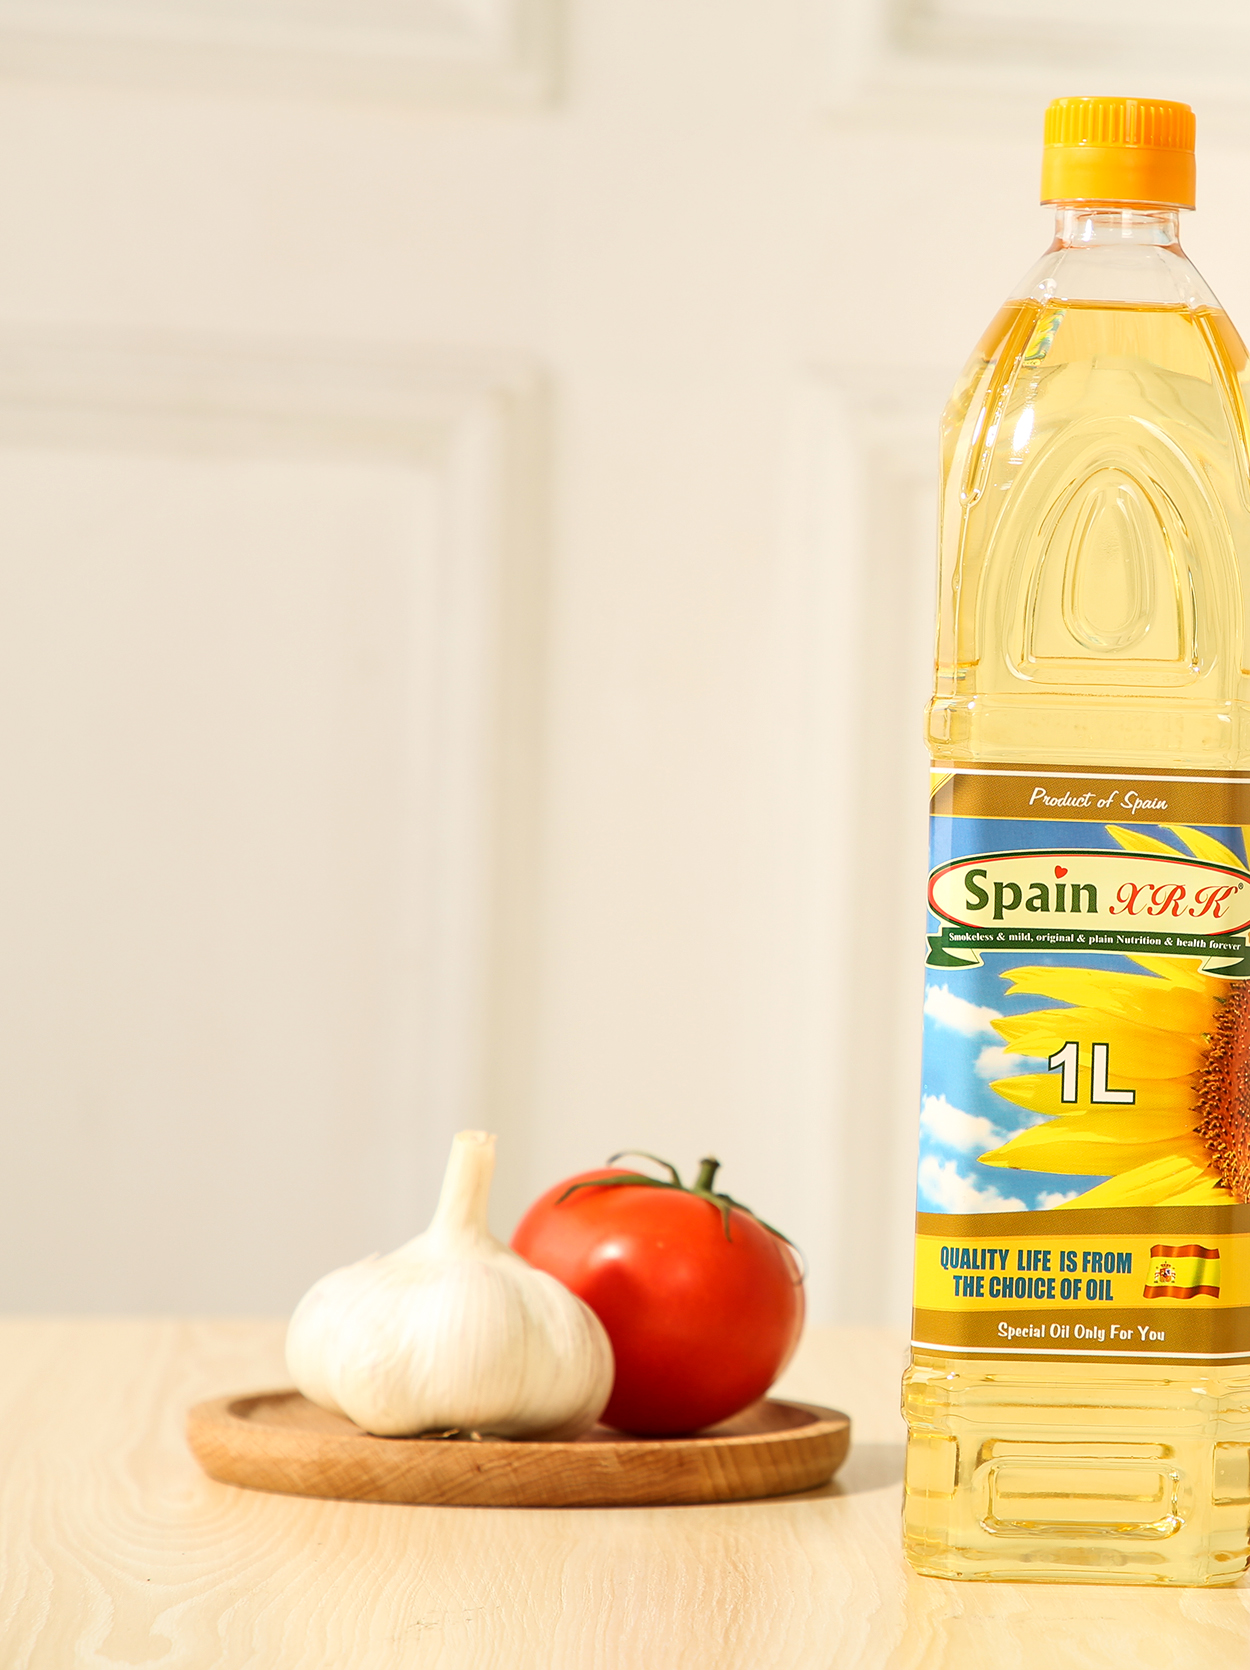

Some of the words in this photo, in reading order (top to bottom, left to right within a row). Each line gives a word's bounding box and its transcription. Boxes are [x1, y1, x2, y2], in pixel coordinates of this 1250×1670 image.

[1029, 787, 1096, 808] Product
[1097, 790, 1120, 808] of
[1120, 790, 1169, 815] Spain
[964, 865, 1099, 921] Spain
[948, 932, 994, 942] Smokeless
[996, 932, 1006, 942] &
[1008, 932, 1034, 943] mild,
[1036, 933, 1075, 944] original
[1076, 934, 1086, 943] &
[1088, 934, 1114, 945] plain
[1116, 935, 1162, 946] Nutrition
[1164, 937, 1174, 946] &
[1176, 937, 1207, 948] health
[1209, 939, 1242, 951] forever
[1048, 1041, 1136, 1105] 1L
[940, 1246, 1009, 1270] QUALITY
[1017, 1249, 1051, 1272] LIFE
[1059, 1250, 1078, 1273] IS
[1082, 1251, 1132, 1274] FROM
[953, 1275, 985, 1298] THE
[989, 1276, 1056, 1300] CHOICE
[1060, 1278, 1083, 1300] OF
[1086, 1278, 1114, 1301] OIL
[997, 1321, 1046, 1340] Special
[1049, 1323, 1070, 1339] Oil
[1074, 1324, 1106, 1342] Only
[1110, 1324, 1134, 1340] For
[1137, 1325, 1166, 1342] You
